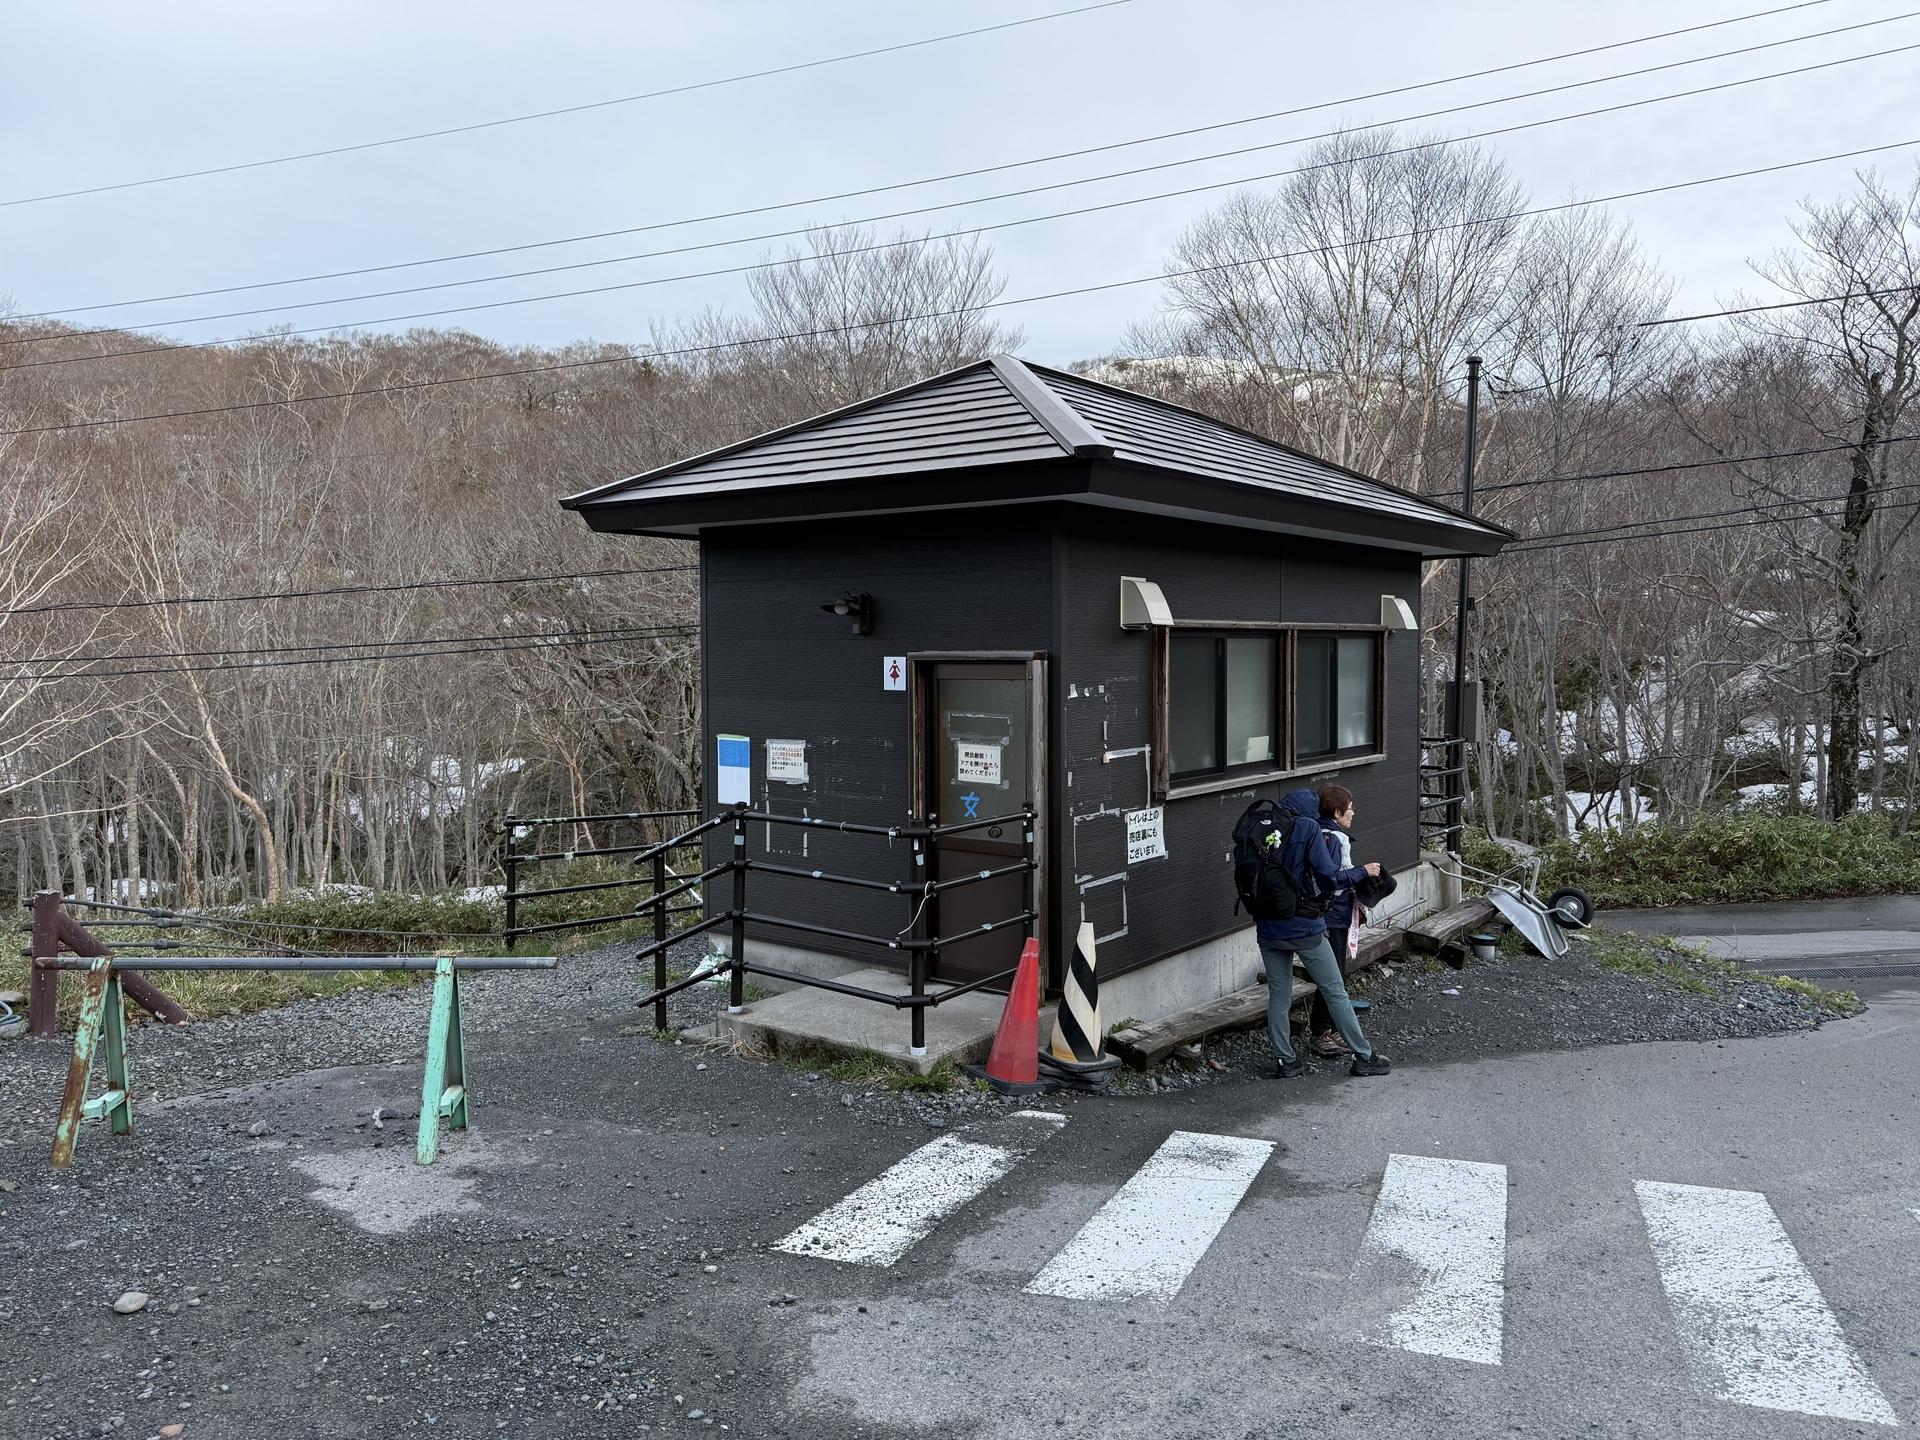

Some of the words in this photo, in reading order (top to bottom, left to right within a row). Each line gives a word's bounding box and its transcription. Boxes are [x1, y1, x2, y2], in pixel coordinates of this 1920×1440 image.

[1129, 809, 1160, 825] トイレは上の
[1129, 827, 1158, 843] 売店裏にも
